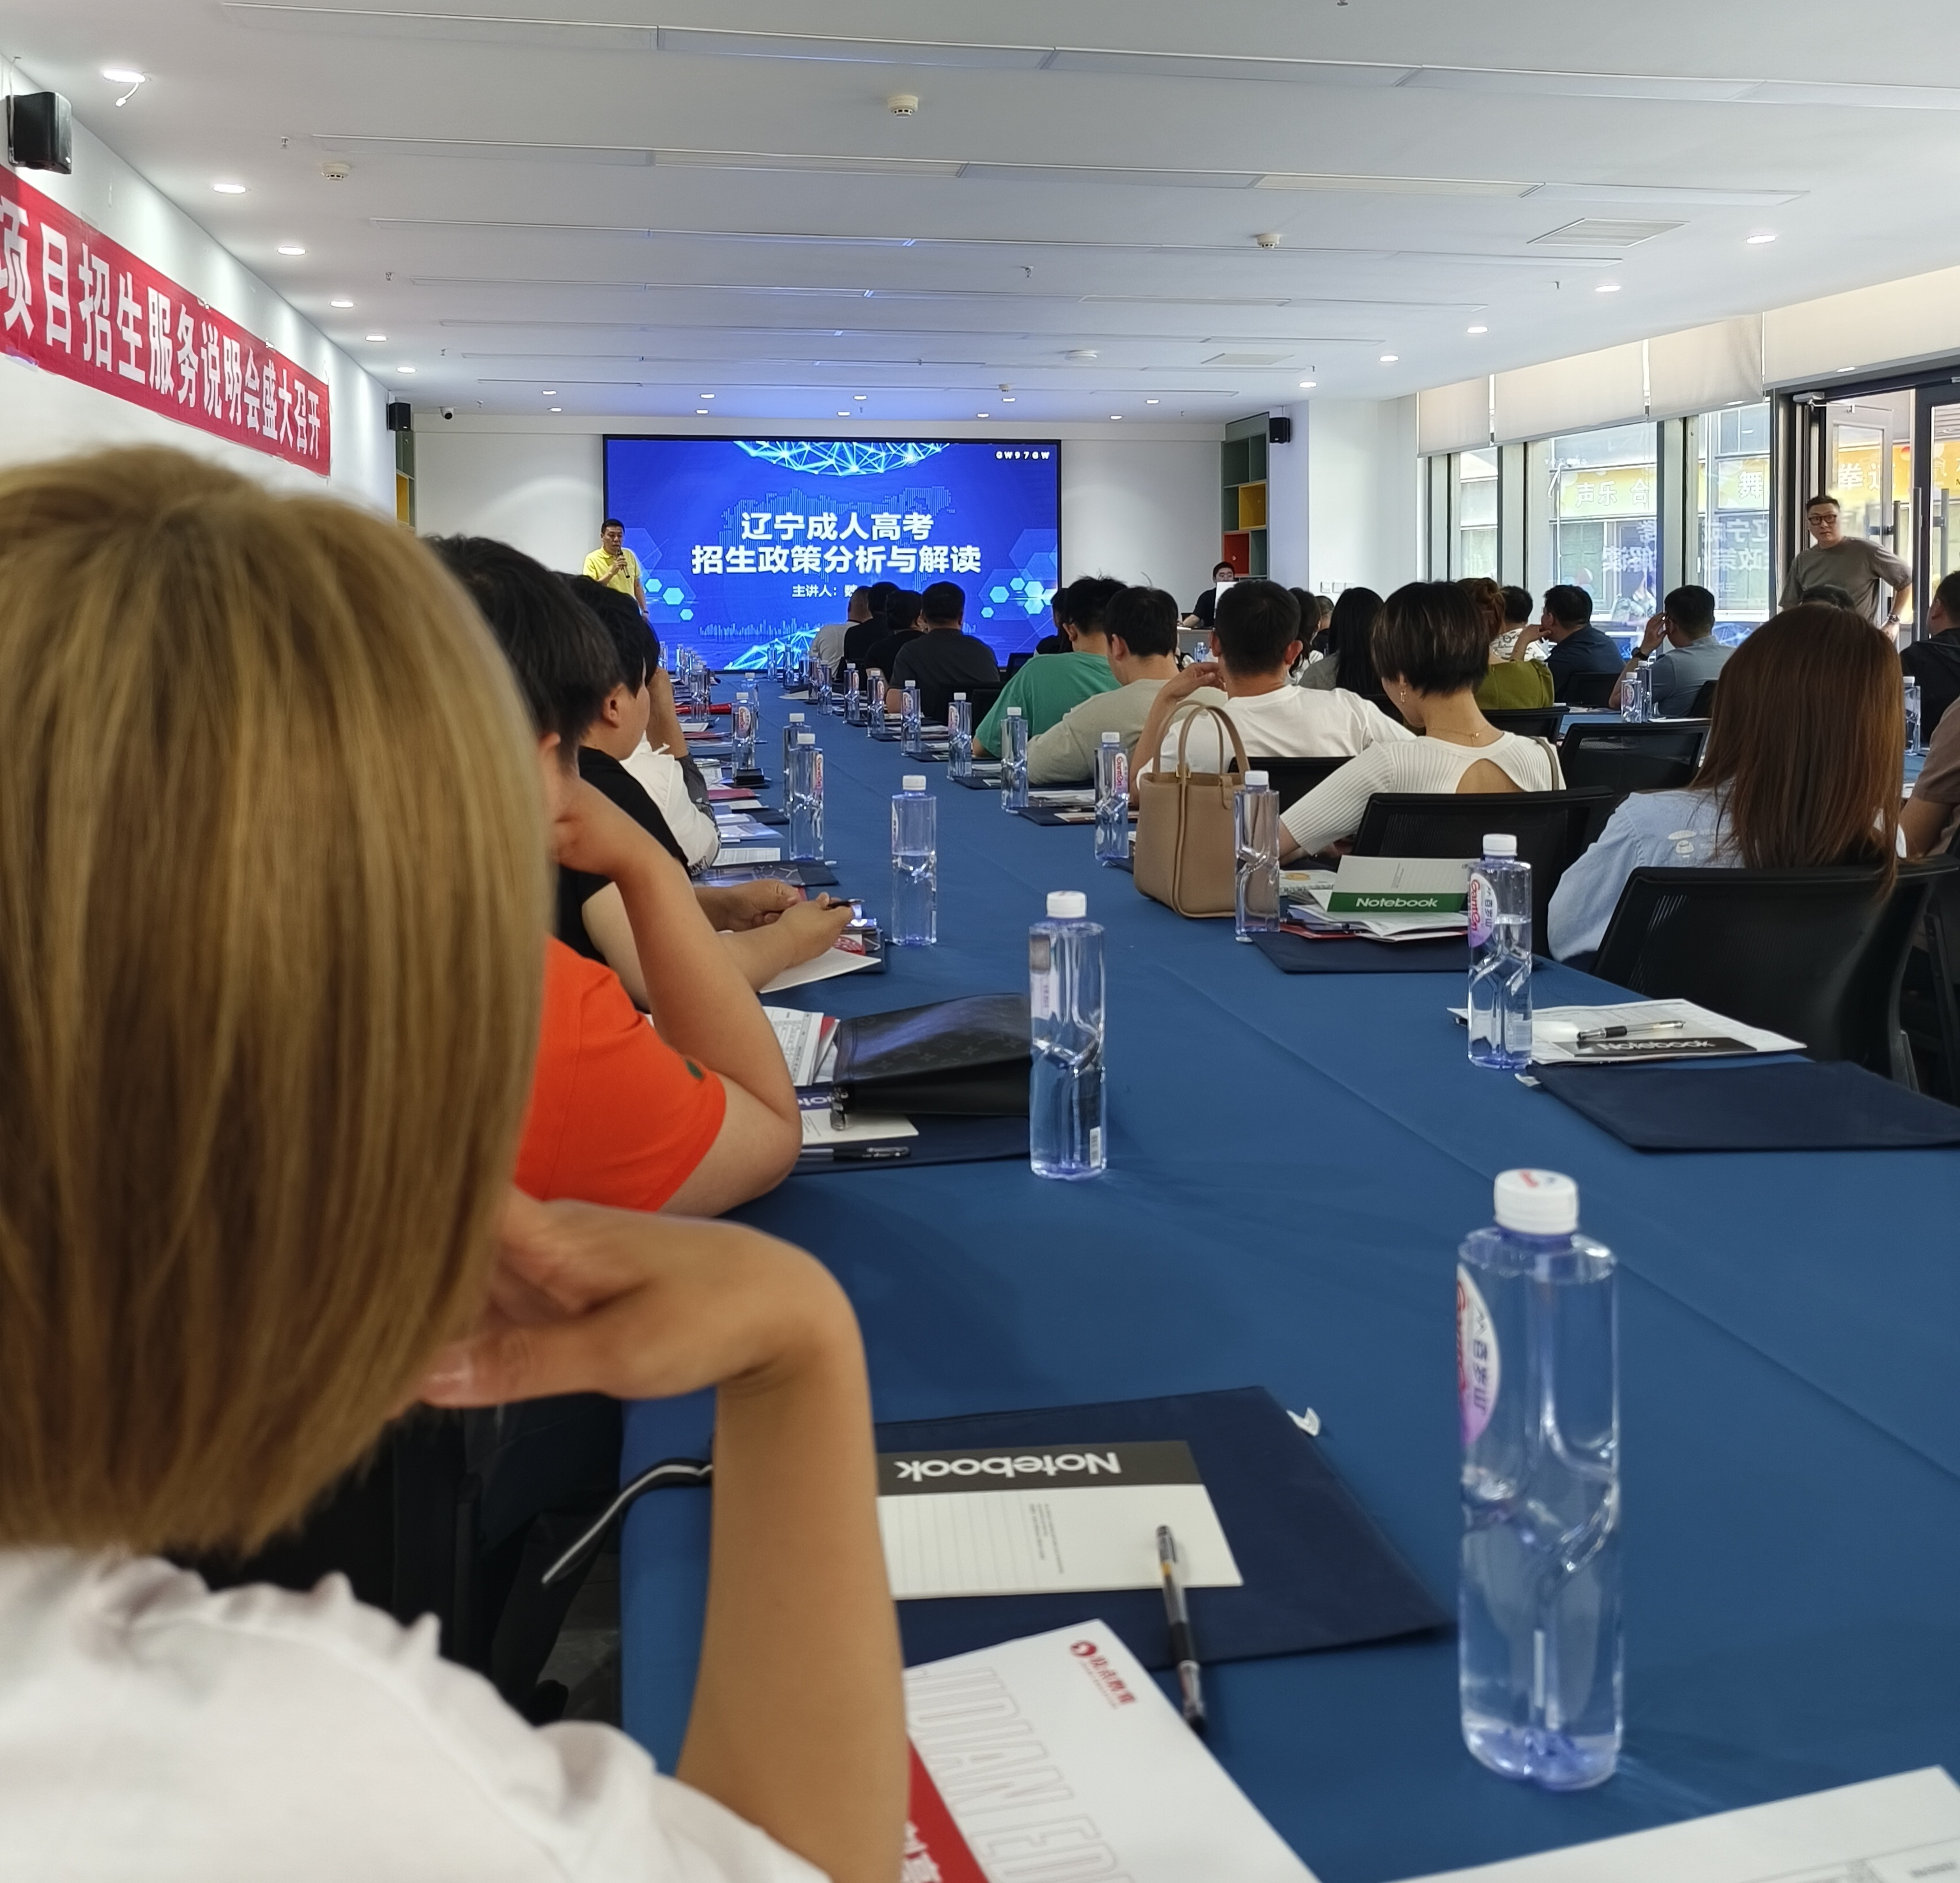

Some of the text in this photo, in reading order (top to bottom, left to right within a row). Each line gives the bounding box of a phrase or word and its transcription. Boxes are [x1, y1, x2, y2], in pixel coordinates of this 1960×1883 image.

[0, 195, 321, 459] 项目招生服务说明会盛大召开
[1575, 481, 1618, 508] 声乐
[741, 512, 934, 540] 辽宁成人高考
[691, 545, 981, 574] 招生政策分析与解读
[1356, 897, 1438, 908] Notebook
[894, 1452, 1122, 1483] Notebook
